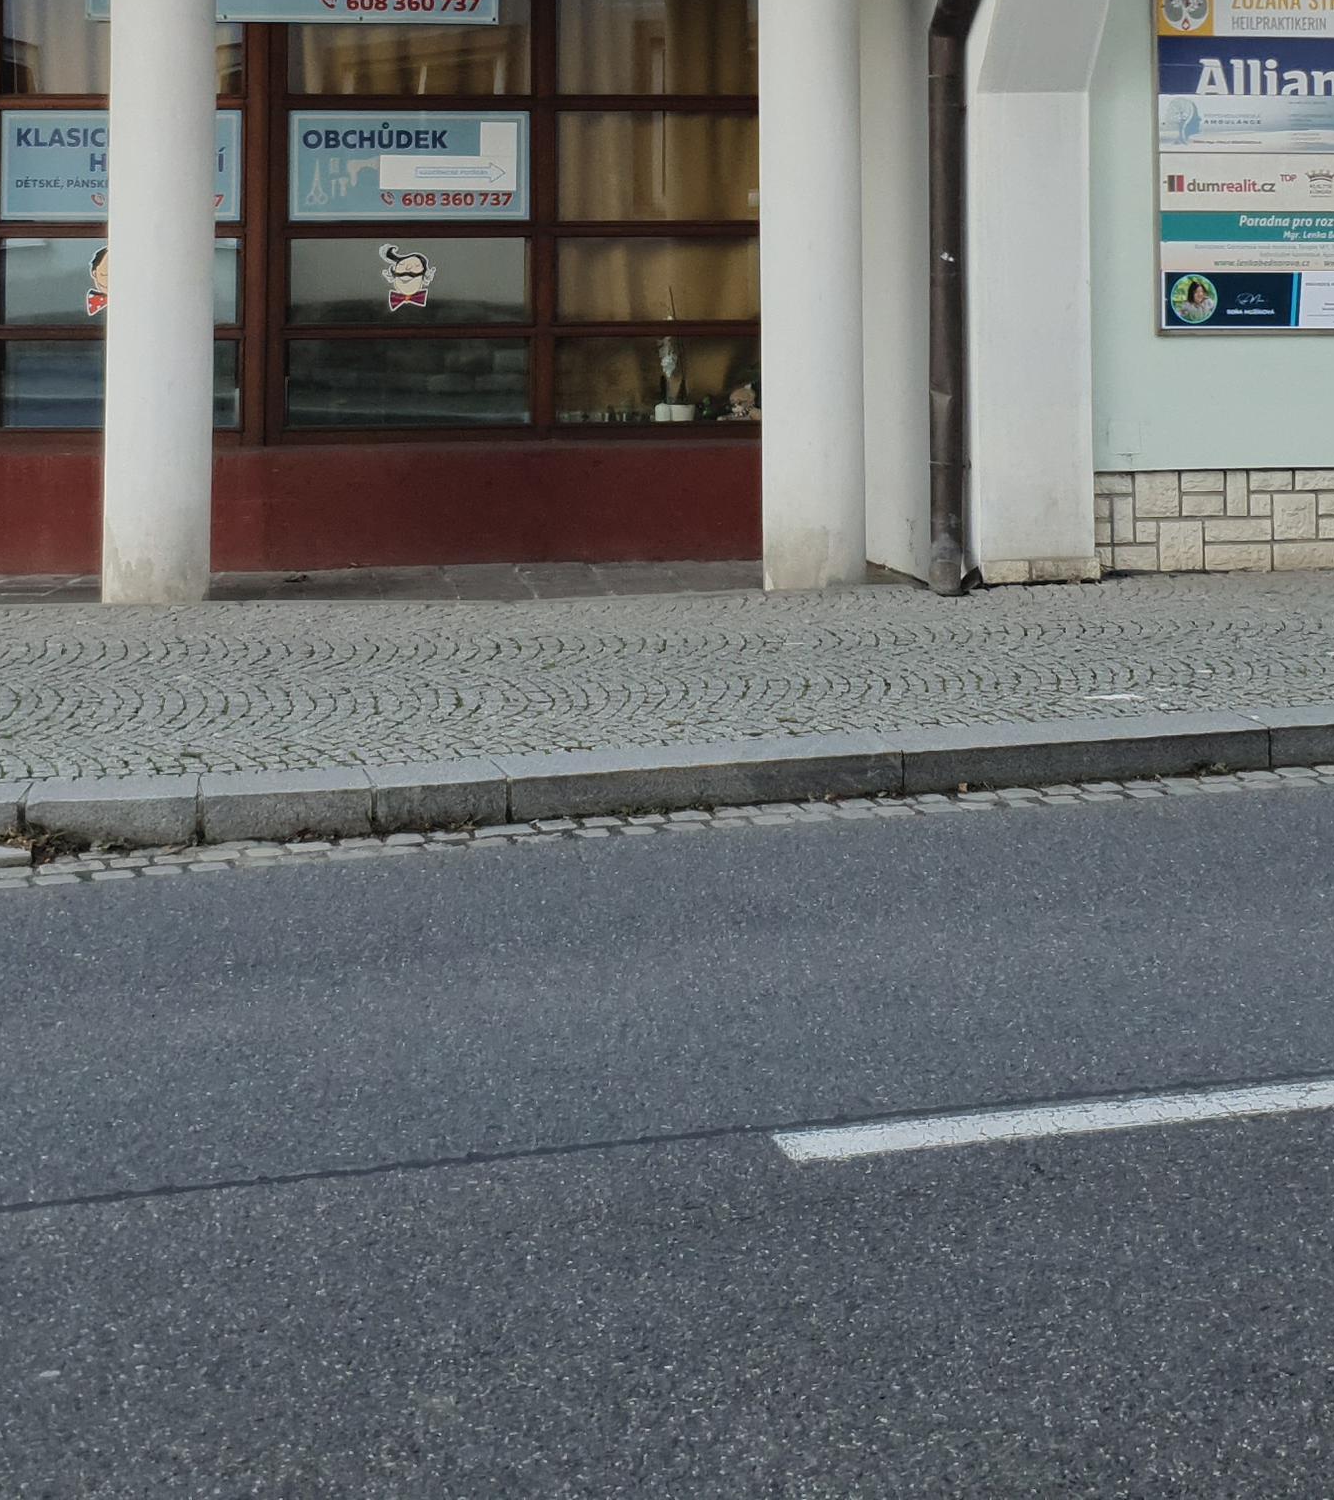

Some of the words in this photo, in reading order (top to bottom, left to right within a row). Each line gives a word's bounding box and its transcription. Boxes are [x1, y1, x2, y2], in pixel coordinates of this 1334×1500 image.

[1231, 16, 1327, 31] HEILPRAKTIKERIN
[16, 127, 109, 148] KLASIC
[302, 121, 448, 149] OBCHŮDEK
[67, 176, 109, 188] PÁNSK
[1187, 179, 1276, 192] dumrealit.cz
[1280, 174, 1297, 182] TOP
[401, 192, 437, 207] 608
[440, 193, 475, 207] 360
[479, 193, 513, 207] 737
[1239, 214, 1291, 227] Poradna
[1292, 218, 1313, 230] pro
